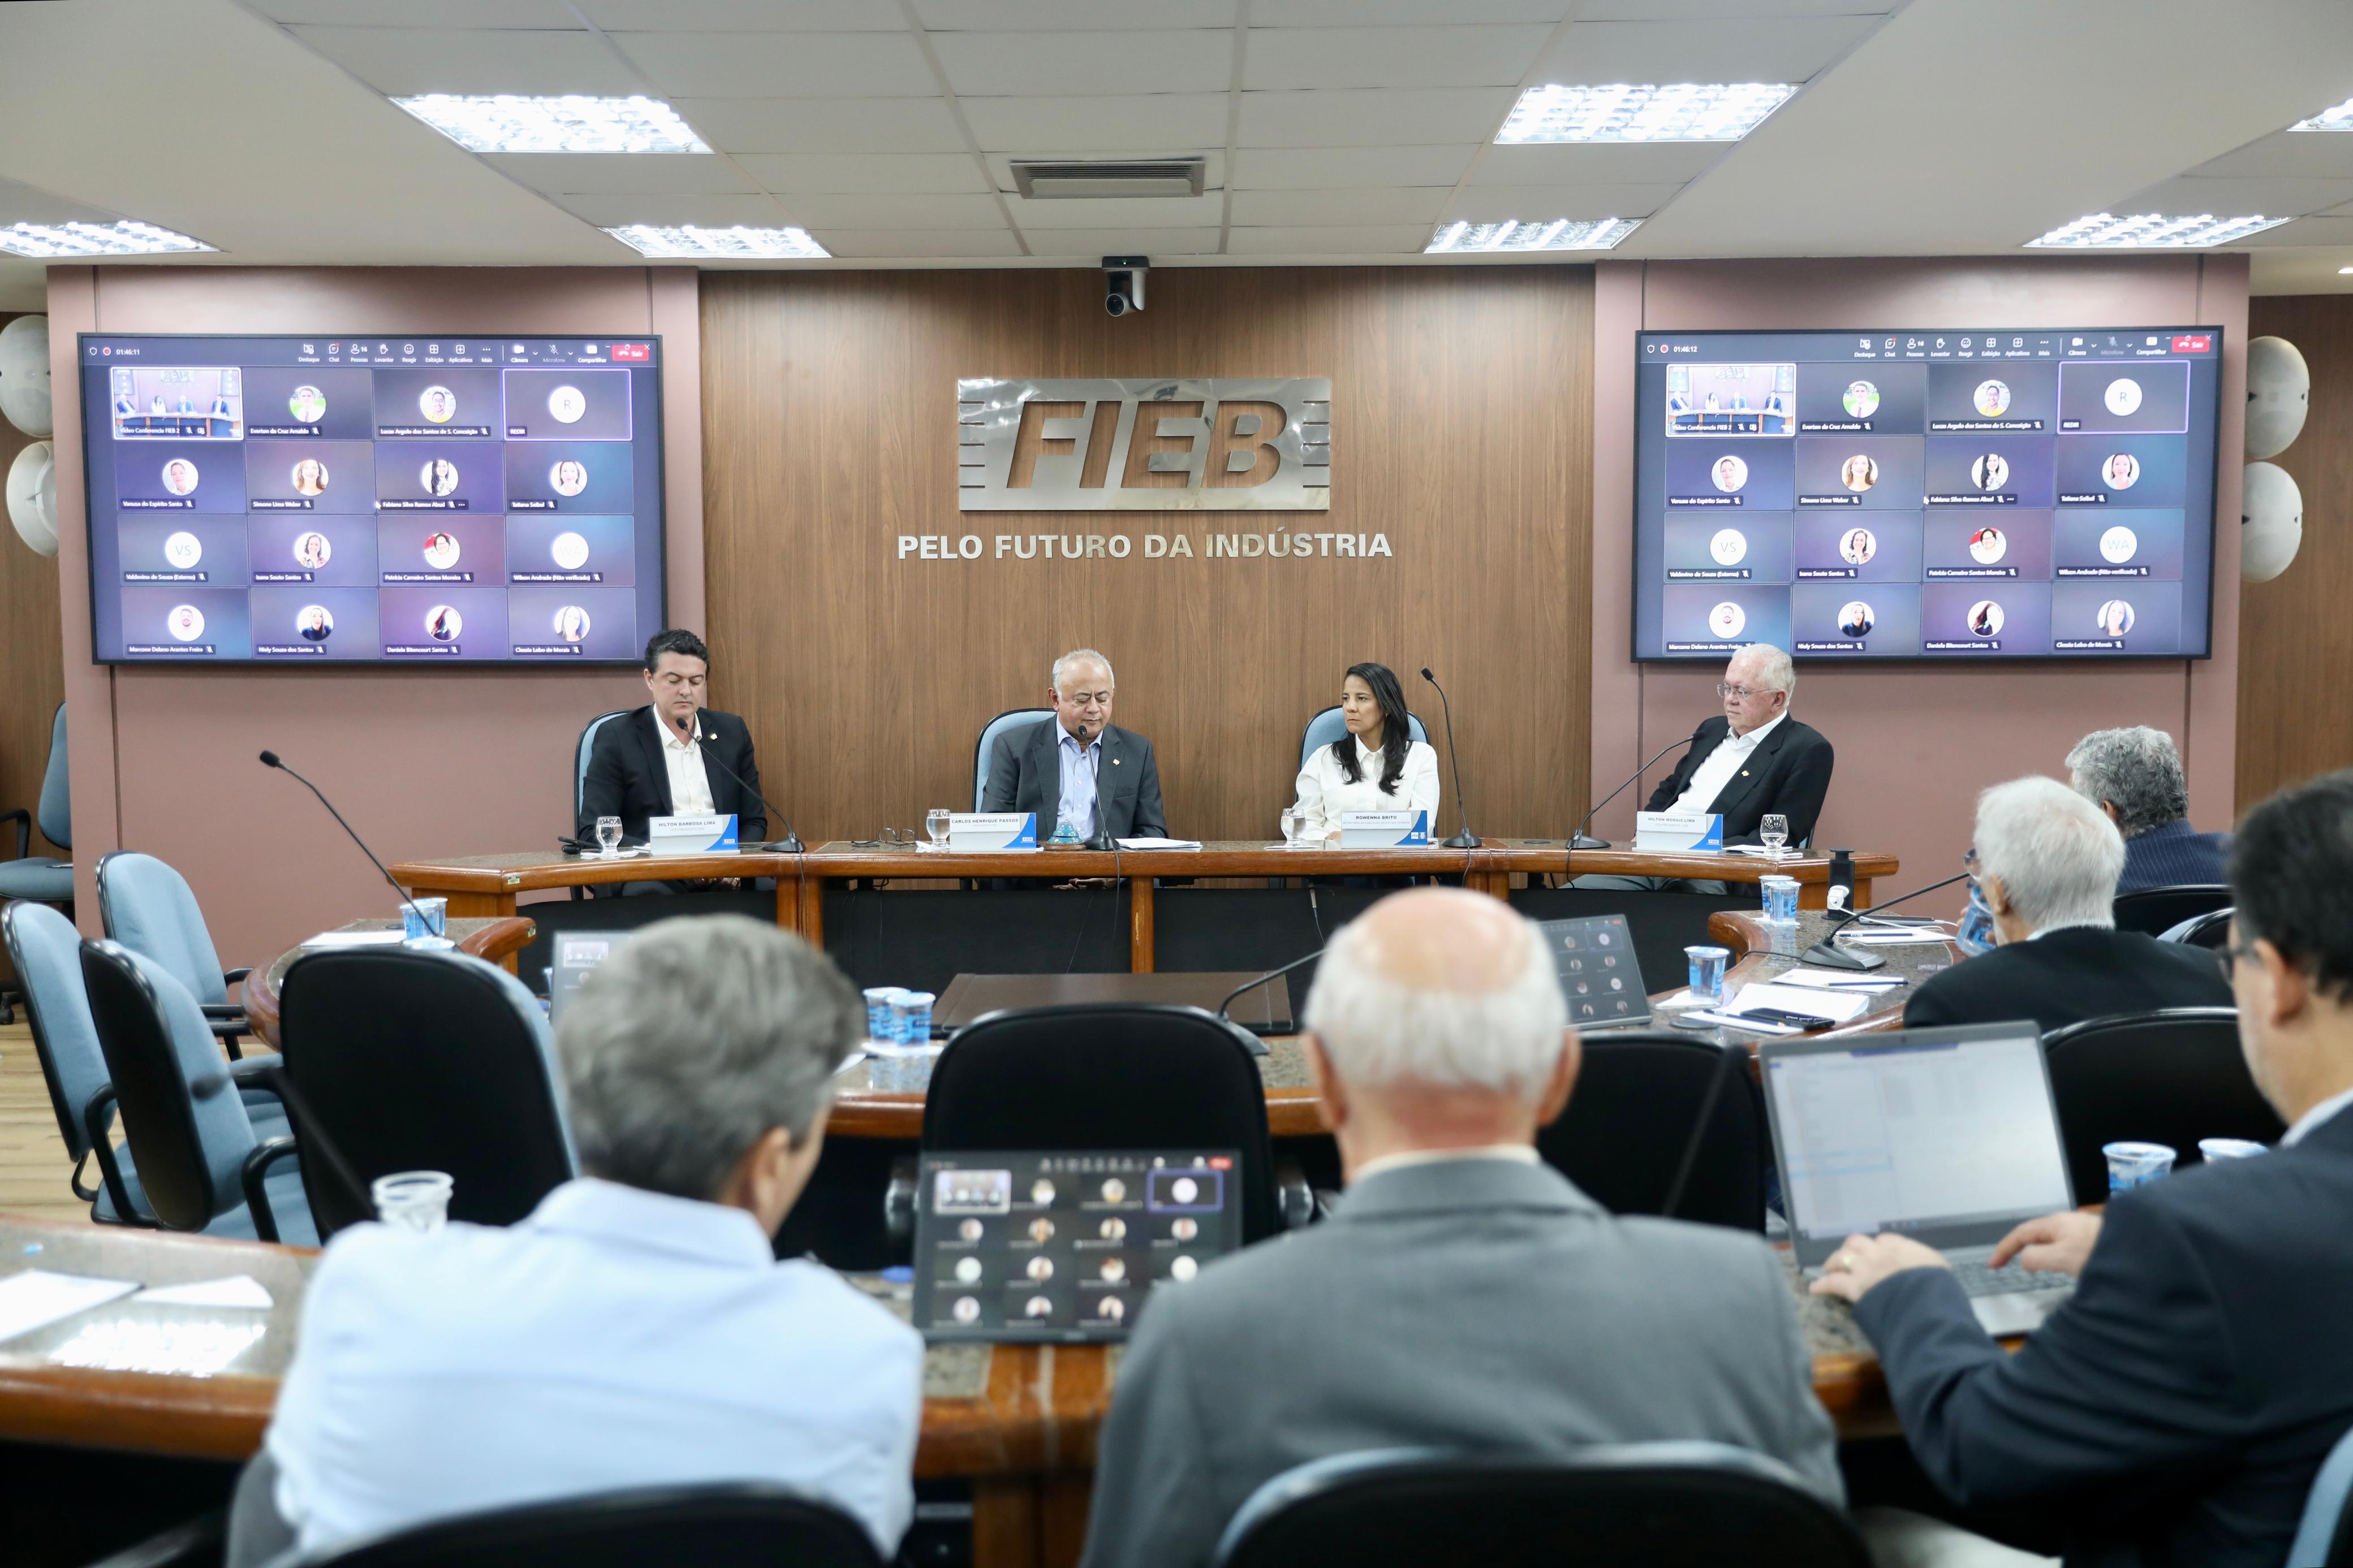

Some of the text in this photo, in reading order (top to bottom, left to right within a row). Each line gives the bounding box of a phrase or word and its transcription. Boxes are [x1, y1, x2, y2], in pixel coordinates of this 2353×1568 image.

[2121, 392, 2127, 402] R
[564, 399, 571, 409] R
[1006, 400, 1287, 489] FIEB
[898, 527, 1393, 560] PELO FUTURO DA INDÚSTRIA
[1721, 542, 1736, 552] VS
[2108, 540, 2129, 550] WA
[175, 545, 191, 556] VS
